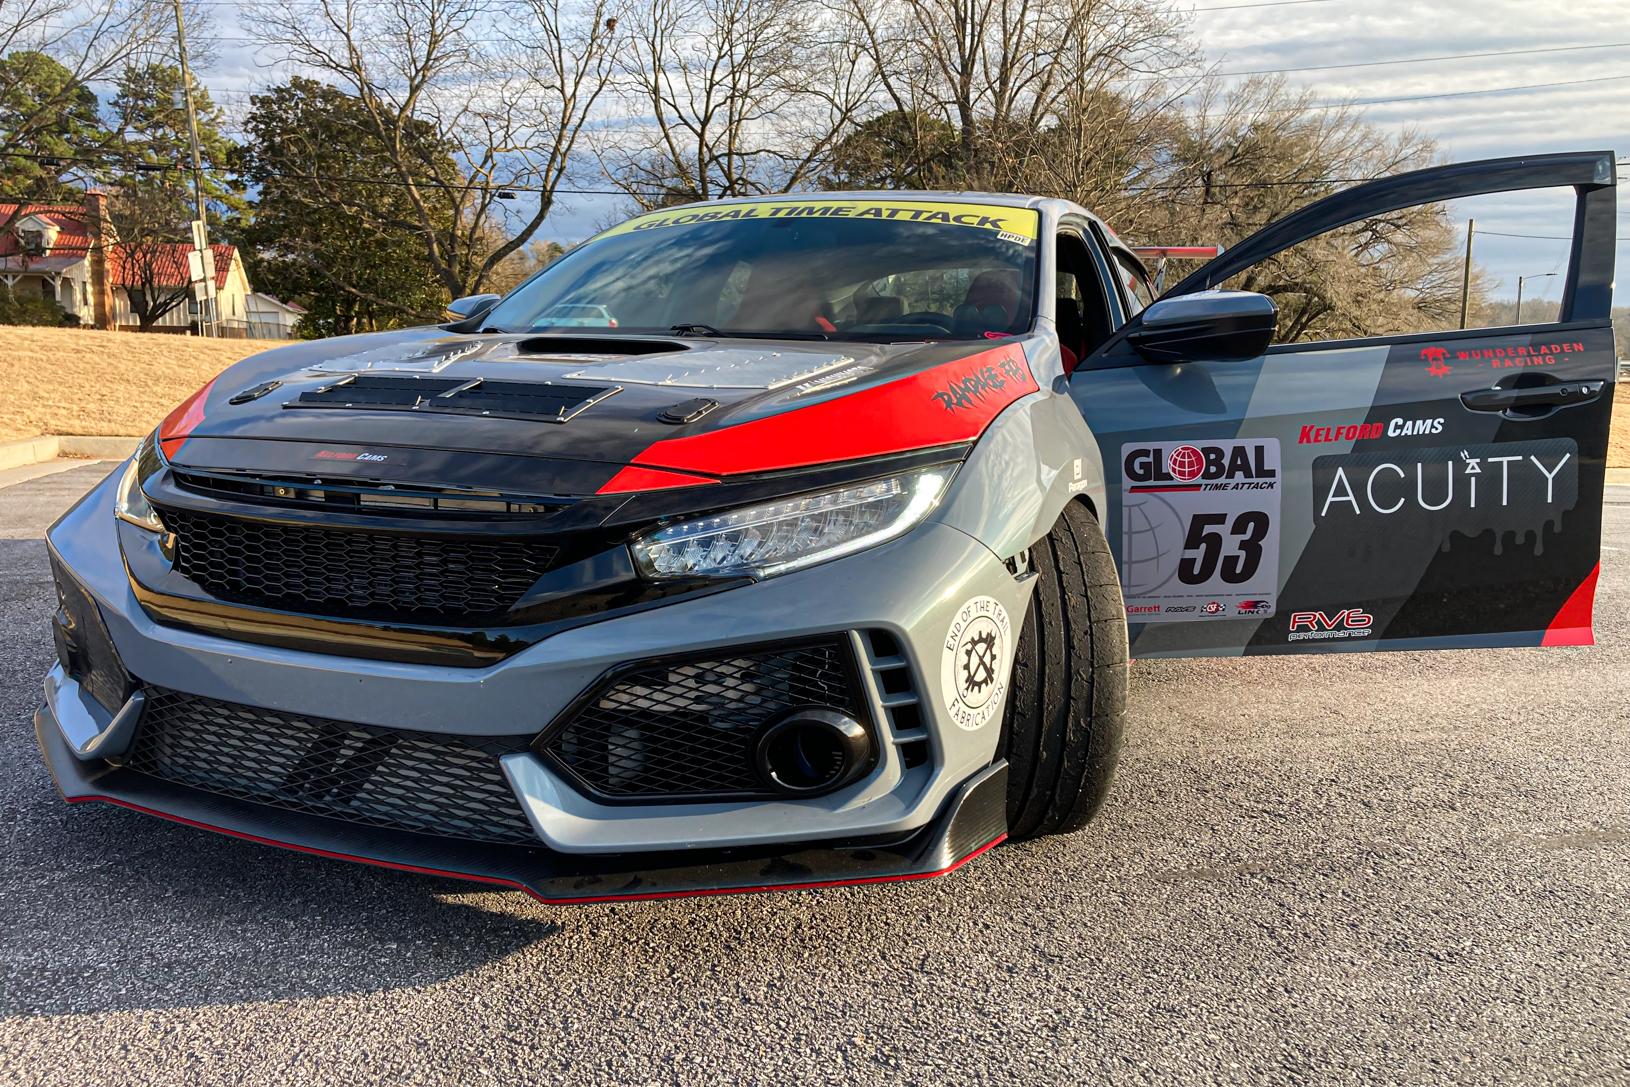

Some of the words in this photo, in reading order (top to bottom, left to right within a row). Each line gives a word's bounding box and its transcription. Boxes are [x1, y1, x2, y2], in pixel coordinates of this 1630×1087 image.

[633, 209, 760, 231] GLOBAL
[768, 206, 857, 217] TIME
[855, 207, 1009, 229] ATTACK
[1457, 342, 1584, 361] WUNDERLADEN
[1492, 354, 1556, 369] RACING
[1298, 422, 1384, 445] KELFORD
[1387, 417, 1445, 438] CAMS
[1124, 444, 1276, 483] GLOBAL
[1203, 483, 1230, 491] TIME
[1231, 481, 1277, 490] ATTACK
[1321, 449, 1571, 517] ACUITY
[1177, 510, 1270, 585] 53
[1126, 605, 1161, 613] Garrett
[1290, 608, 1373, 631] RV6
[946, 622, 962, 652] END
[961, 605, 972, 623] OF
[974, 599, 991, 613] THE
[992, 602, 1009, 636] TRAIL
[1288, 629, 1372, 642] performance
[948, 681, 1005, 728] FABRICATION
